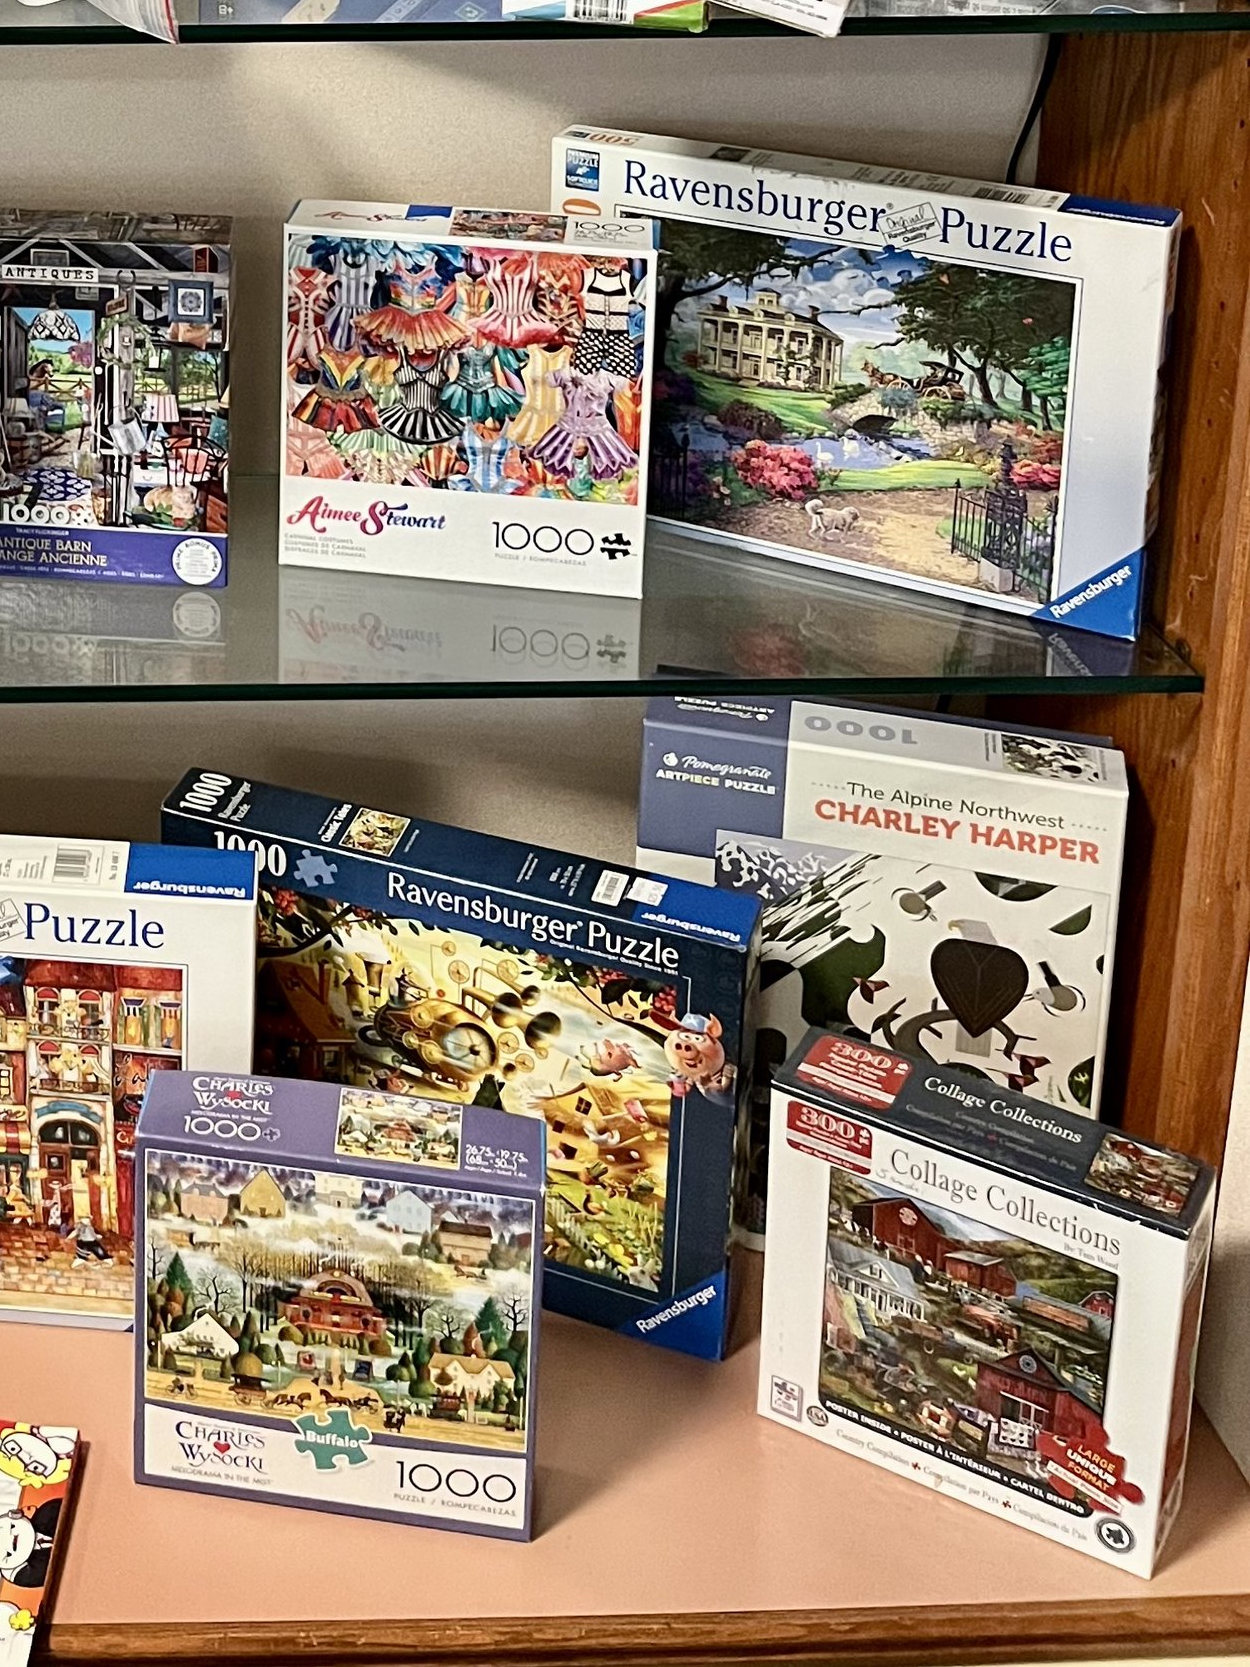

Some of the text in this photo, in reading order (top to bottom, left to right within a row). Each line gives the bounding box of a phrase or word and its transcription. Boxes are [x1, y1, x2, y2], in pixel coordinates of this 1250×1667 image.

[568, 158, 599, 168] PUZZLE
[625, 161, 1073, 262] Ravensburger Puzzle
[5, 267, 95, 280] ANTIQUES
[286, 495, 446, 535] Aimee Stewart
[56, 538, 92, 552] BARN
[492, 521, 594, 555] 1000
[39, 551, 107, 566] ANCIENNE
[1049, 564, 1133, 620] Ravensburger
[656, 768, 776, 795] ARTPIECE PUZZLE
[682, 755, 772, 780] Pomegranate
[179, 772, 232, 812] 1000
[847, 781, 1065, 829] The Alpine Northwest
[813, 798, 1101, 865] CHARLEY HARPER
[133, 881, 246, 898] Ravensburger
[24, 902, 165, 949] Puzzle
[388, 871, 680, 968] Ravensburger Puzzle
[830, 1041, 893, 1069] 300
[800, 1107, 855, 1139] 300
[925, 1076, 987, 1108] Collage
[990, 1099, 1083, 1144] Collections
[183, 1116, 261, 1142] 1000
[891, 1148, 1121, 1256] Collage Collections
[635, 1282, 718, 1334] Ravensburger
[306, 1430, 359, 1449] Buffalo
[1066, 1448, 1117, 1486] UNIQUE
[1077, 1443, 1116, 1473] LARGE
[396, 1460, 516, 1503] 1000
[1066, 1460, 1110, 1491] FORMAT
[393, 1493, 517, 1517] PUZZLE ROMPECABEZAS
